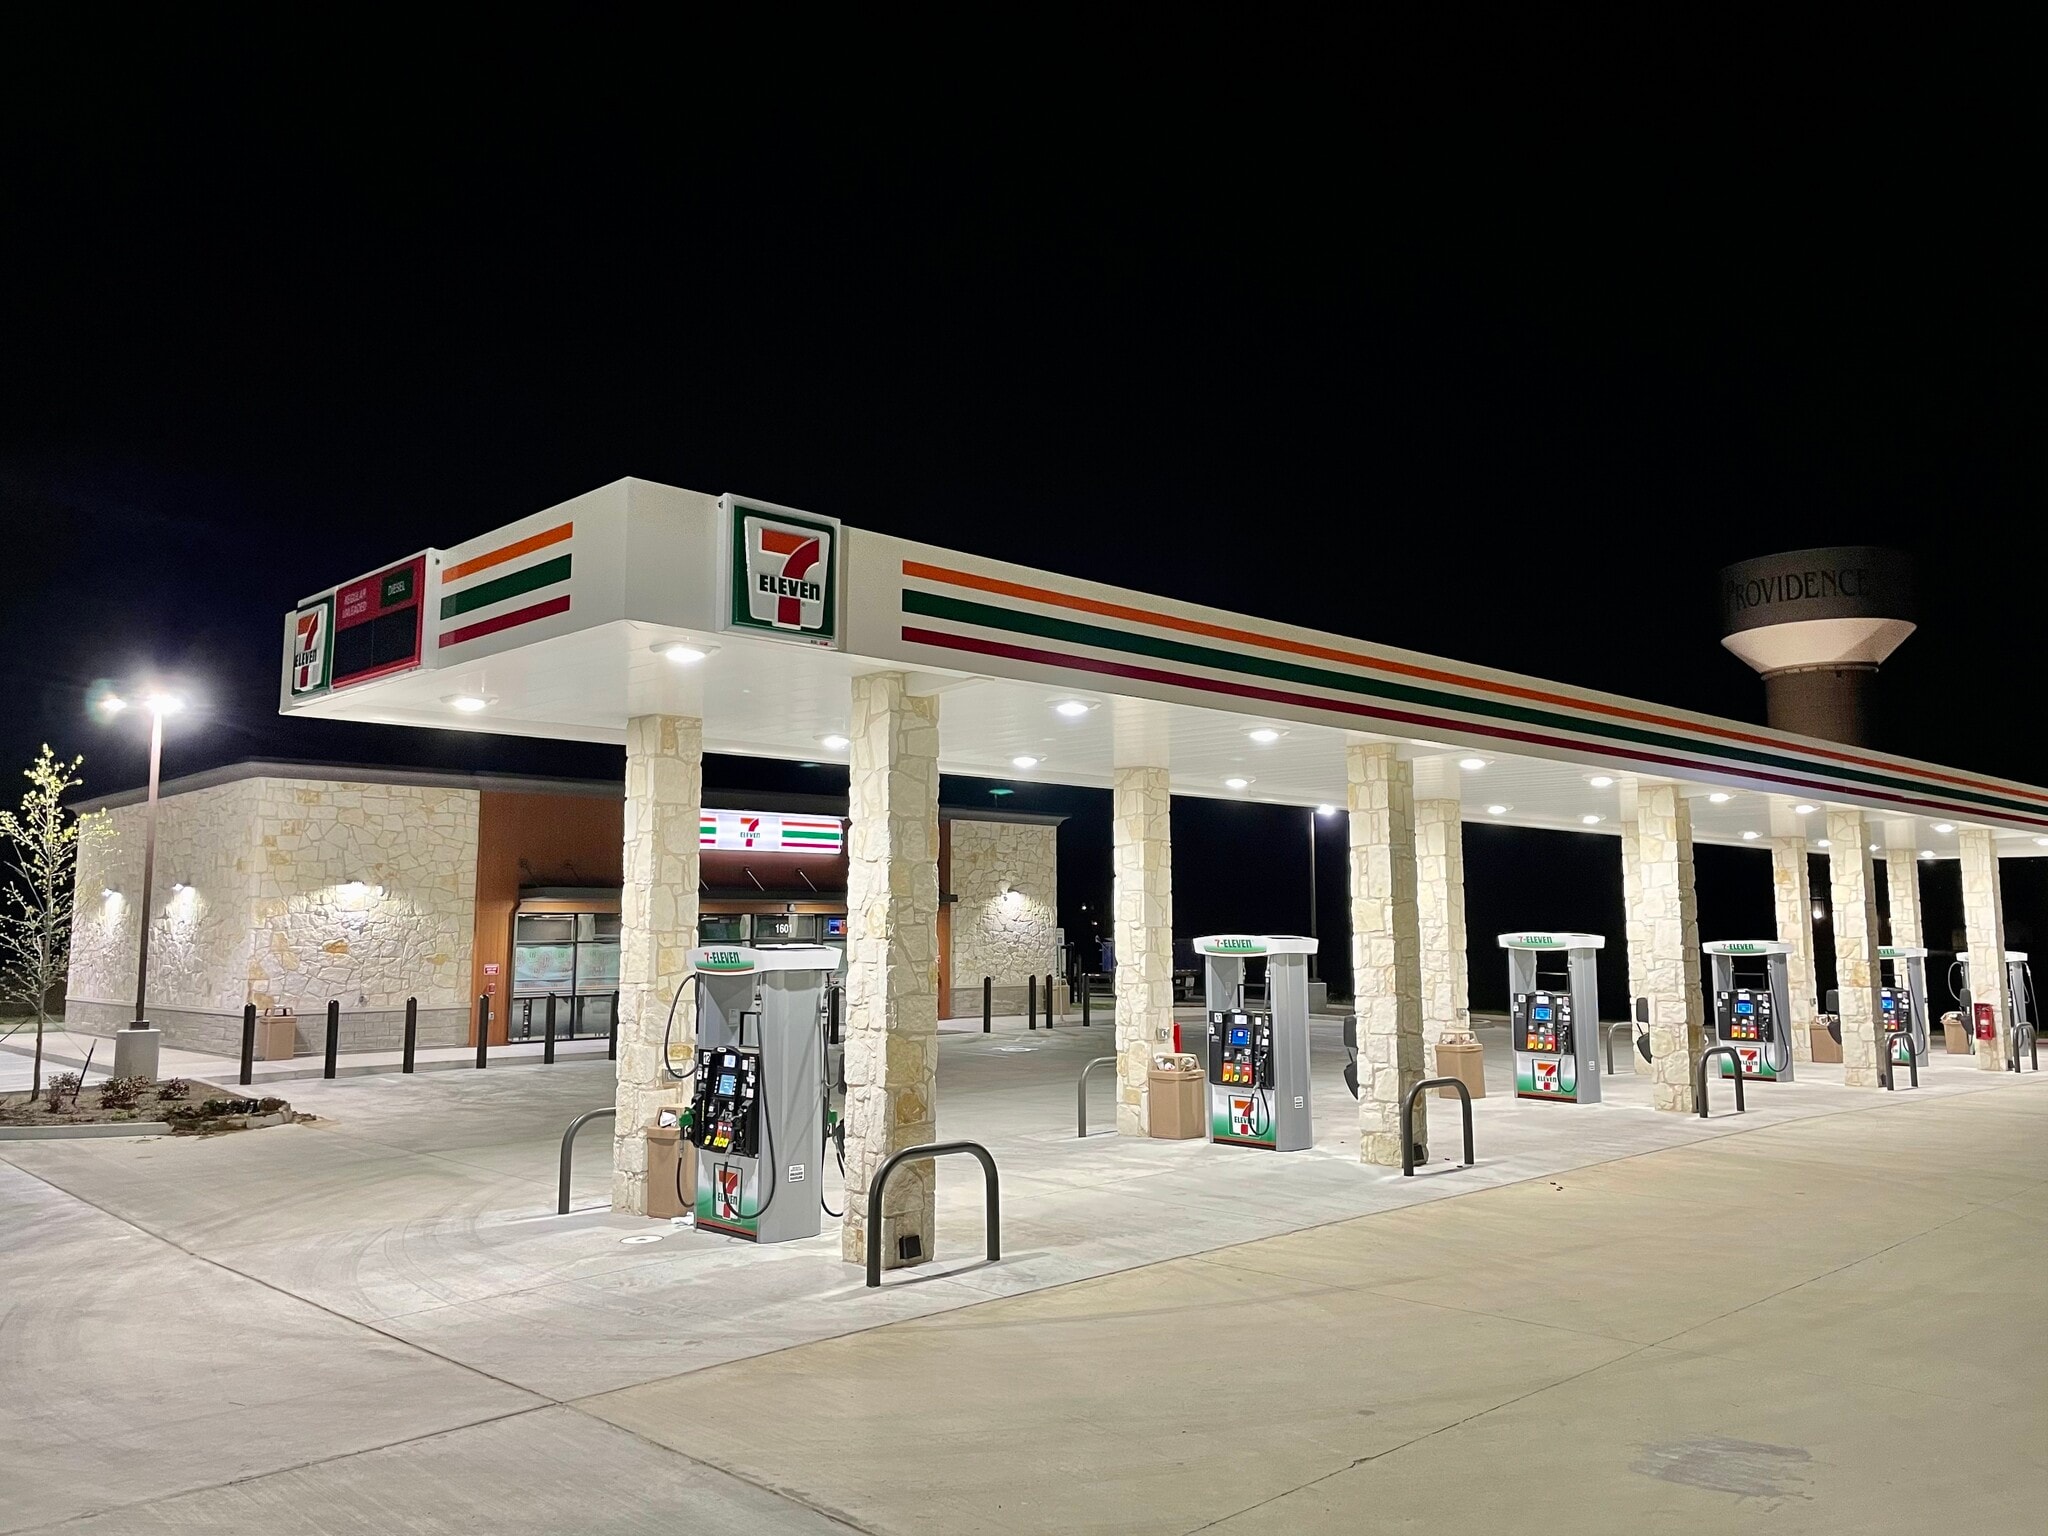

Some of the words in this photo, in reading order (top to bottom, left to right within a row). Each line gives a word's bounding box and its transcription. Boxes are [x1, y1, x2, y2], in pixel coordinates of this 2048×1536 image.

[760, 528, 820, 626] 7
[1724, 568, 1870, 613] PROVIDENCE
[298, 611, 318, 688] 7
[740, 818, 759, 847] 7
[775, 923, 793, 934] 1601
[1537, 1063, 1556, 1090] 7
[1740, 1050, 1757, 1072] 7
[1234, 1100, 1254, 1134] 7
